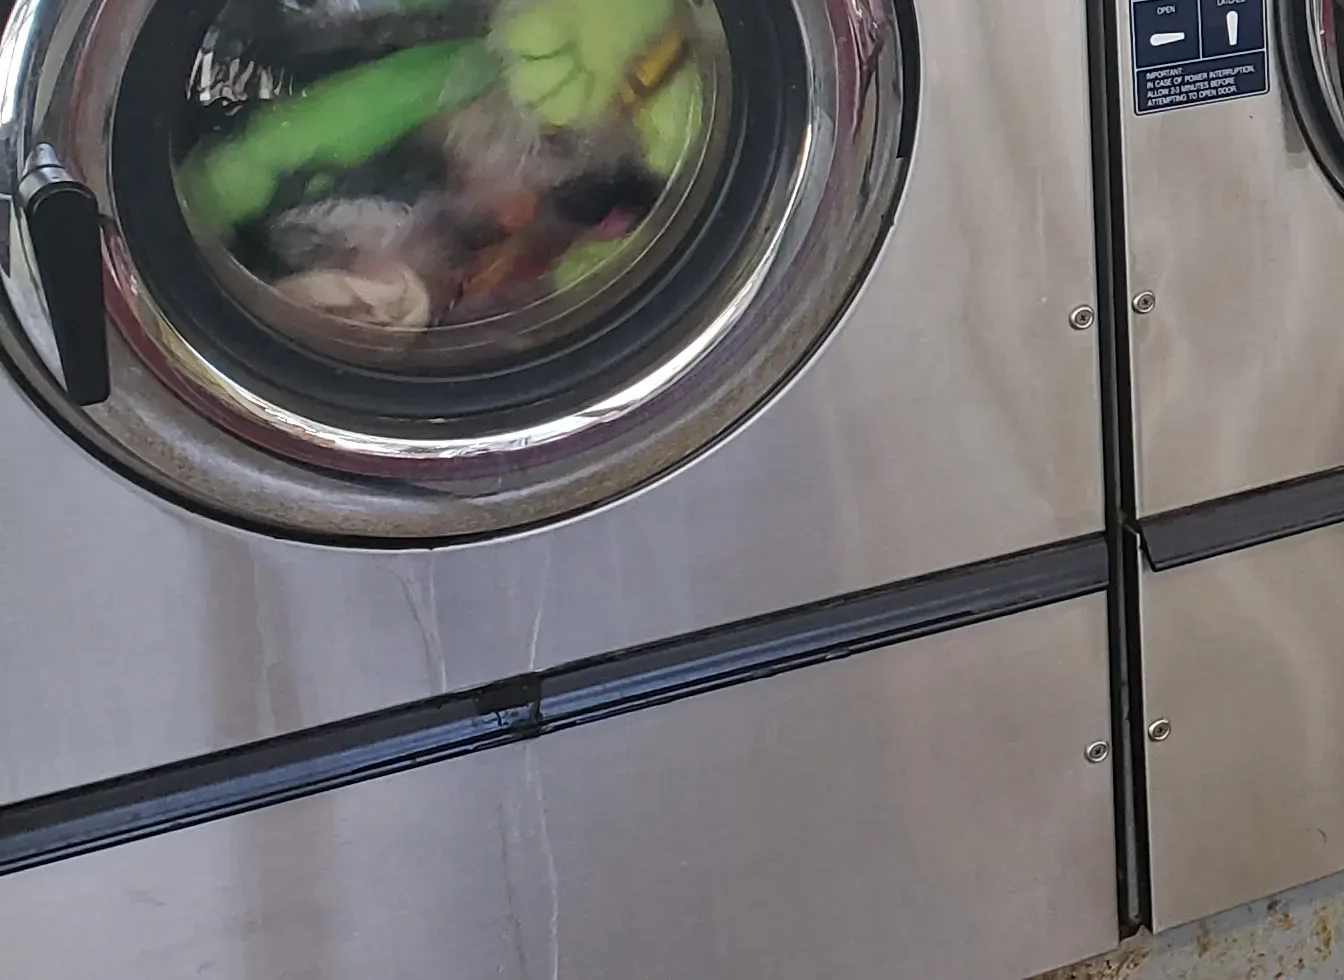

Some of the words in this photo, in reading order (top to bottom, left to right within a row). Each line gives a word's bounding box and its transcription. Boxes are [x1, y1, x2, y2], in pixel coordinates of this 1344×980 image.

[1157, 5, 1175, 15] OPEN
[1147, 89, 1169, 98] ALLOW
[1181, 81, 1209, 92] MINUTES
[1211, 77, 1236, 86] BEFORE
[1155, 78, 1172, 87] CASE
[1185, 73, 1207, 82] POWER
[1147, 95, 1187, 106] ATTEMPTING
[1199, 89, 1216, 98] OPEN
